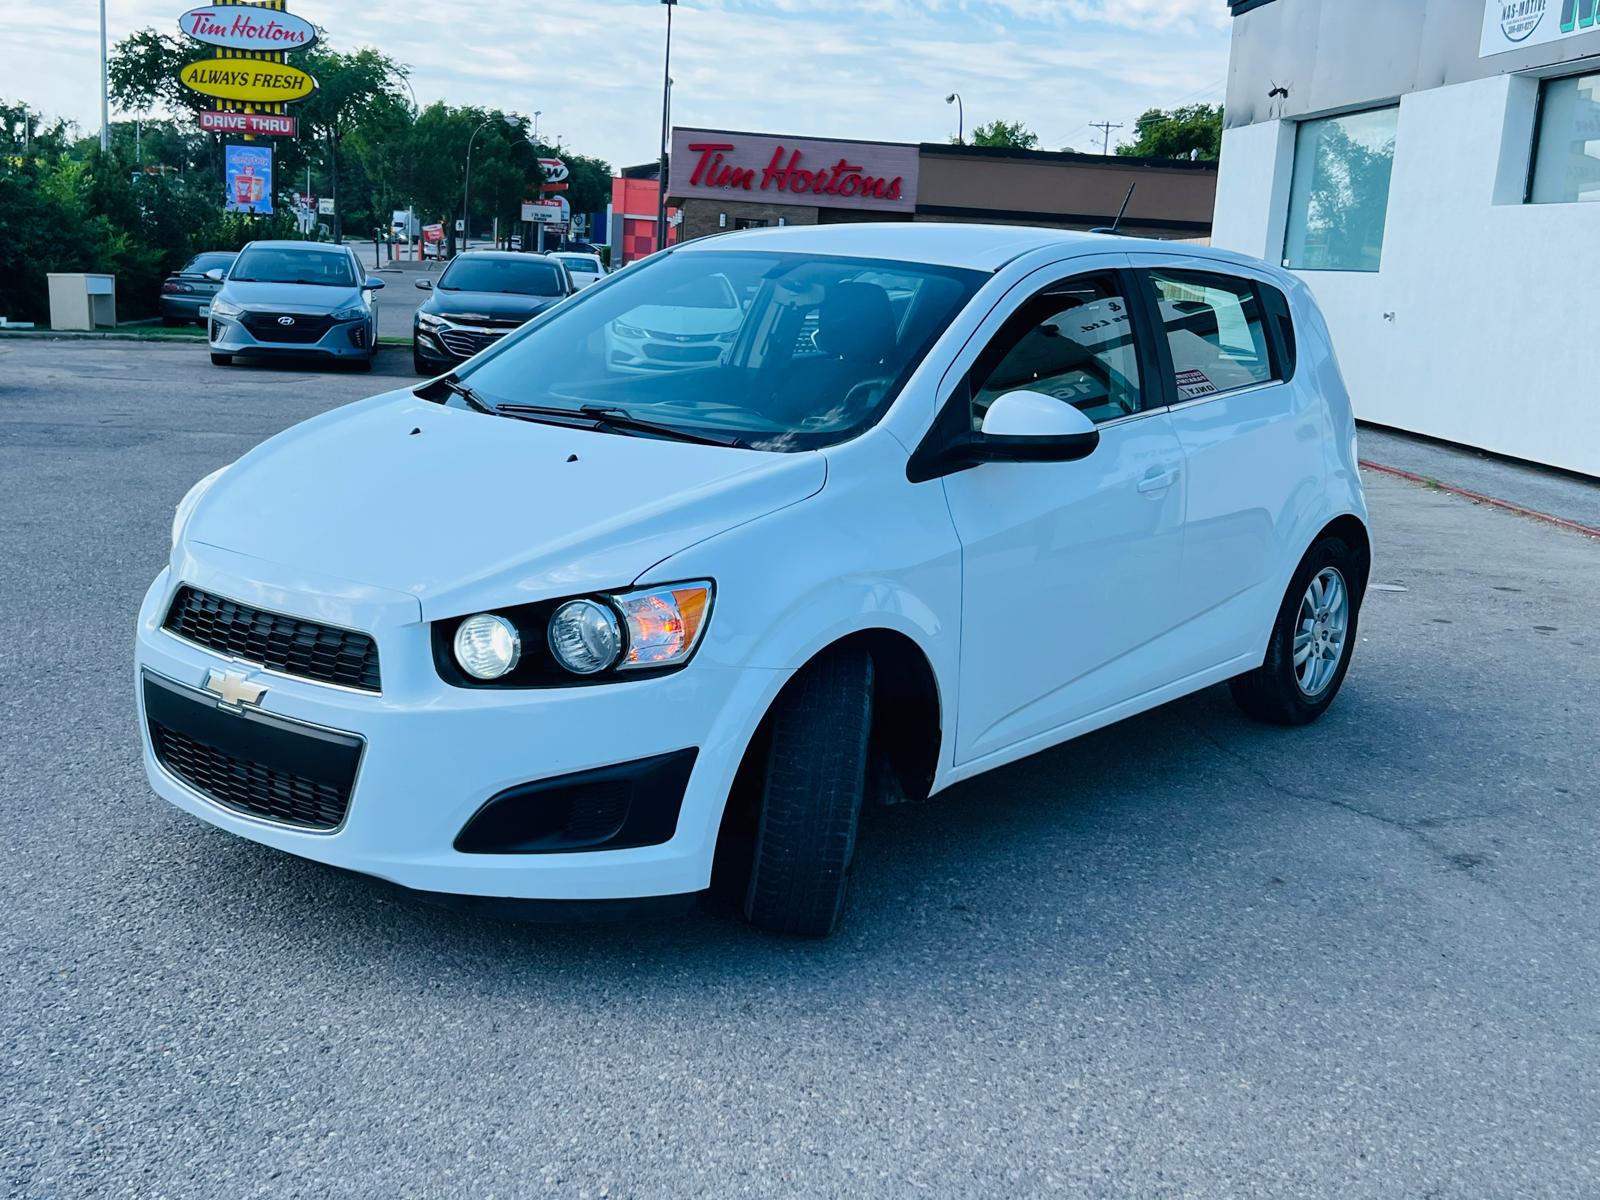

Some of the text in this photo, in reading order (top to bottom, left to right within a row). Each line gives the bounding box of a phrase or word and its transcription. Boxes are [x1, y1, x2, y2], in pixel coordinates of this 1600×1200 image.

[190, 13, 305, 43] Tim Hortons
[188, 68, 305, 90] ALWAYS FRESH
[203, 115, 290, 133] DRIVE THRU
[688, 143, 904, 200] Tim Hortons
